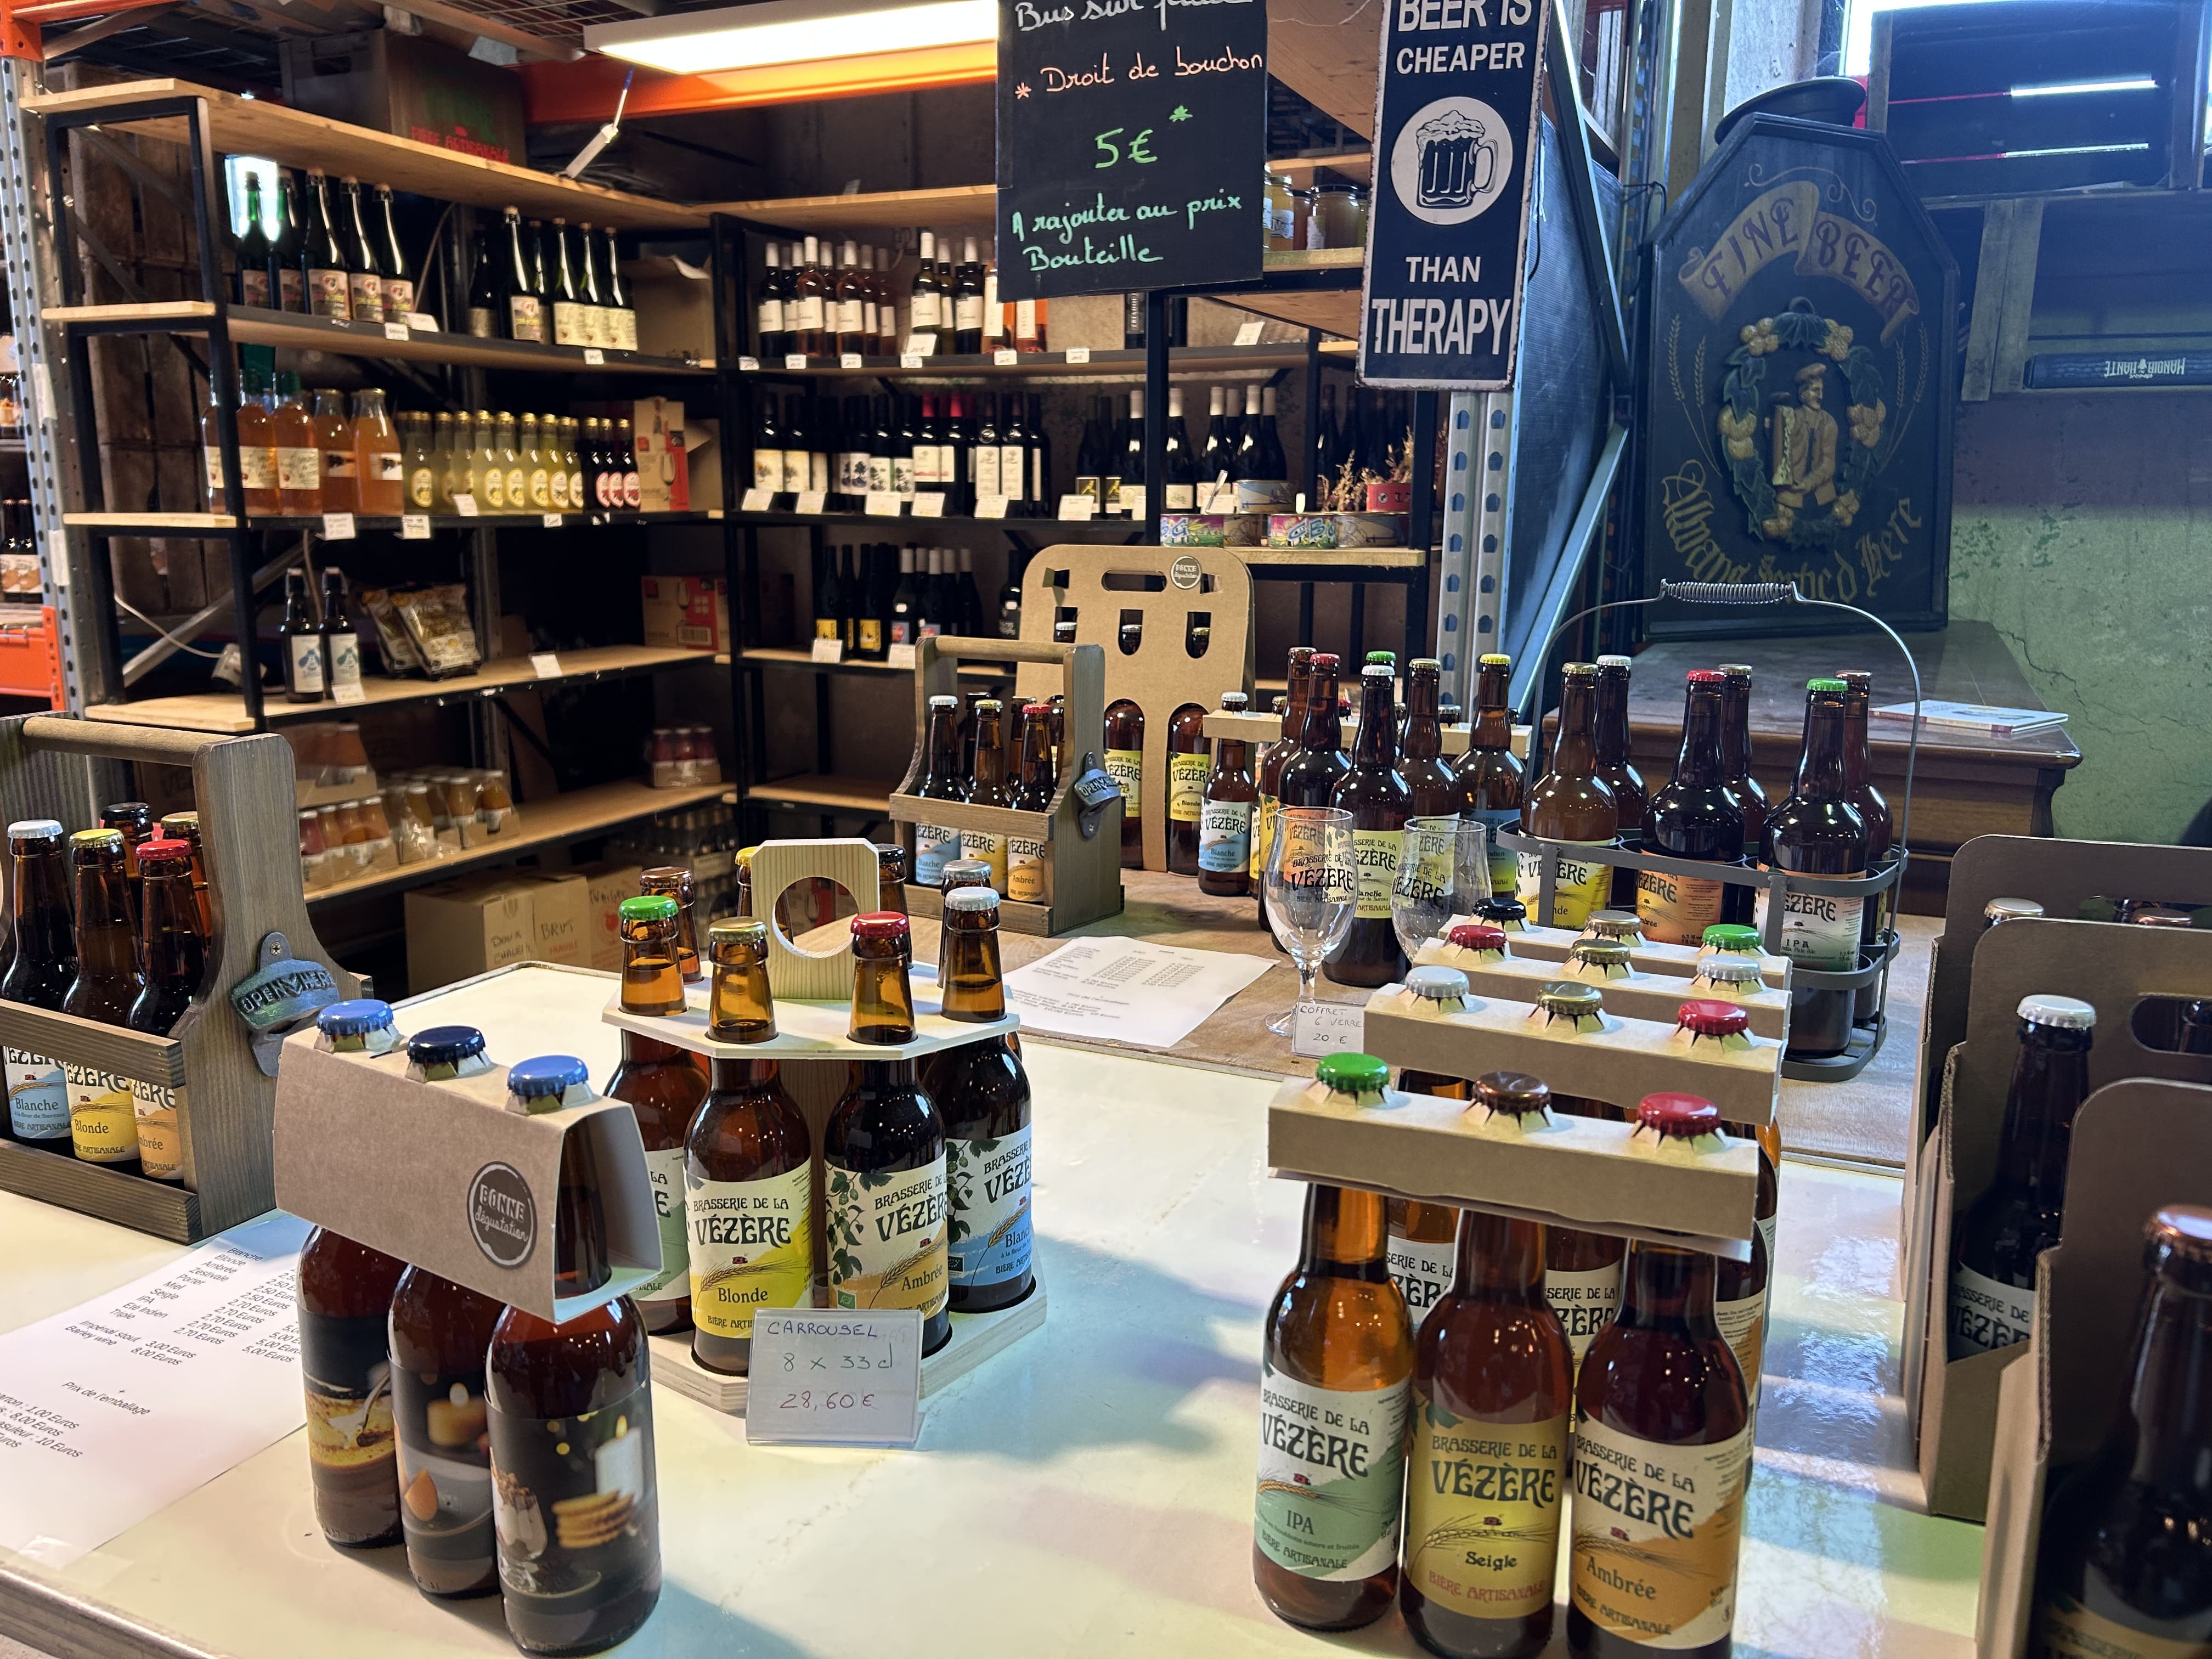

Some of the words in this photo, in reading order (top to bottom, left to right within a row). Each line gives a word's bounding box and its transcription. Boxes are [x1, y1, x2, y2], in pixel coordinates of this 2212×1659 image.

[1015, 2, 1075, 31] Bus
[1398, 0, 1486, 32] BEER
[1501, 0, 1531, 26] IS
[1396, 42, 1525, 75] CHEAPER
[1040, 52, 1115, 92] Droit
[1128, 53, 1159, 78] de
[1173, 46, 1263, 77] bouchon
[1012, 211, 1025, 241] A
[1032, 192, 1131, 244] rajouter
[1136, 205, 1177, 219] au
[1186, 189, 1242, 230] prix
[1023, 234, 1163, 272] Bouteille
[1701, 196, 1802, 300] FINE
[1815, 221, 1910, 314] BEER
[1405, 256, 1481, 283] THAN
[1372, 298, 1511, 356] THERAPY
[2147, 357, 2186, 375] MANOIR
[1855, 497, 1922, 598] Here
[1205, 816, 1246, 834] VÉZÈRE
[1211, 848, 1235, 856] Blanche
[1388, 842, 1397, 851] LA
[1355, 848, 1396, 872] ÉZÈRE
[1013, 874, 1036, 884] Ambrée
[1291, 866, 1354, 893] VÉZÈRE
[1423, 865, 1432, 877] DE
[1435, 871, 1446, 884] LA
[541, 919, 574, 939] BRUT
[1786, 939, 1809, 949] IPA
[1300, 1006, 1348, 1015] COFFRET
[1314, 1017, 1323, 1025] 6
[15, 1097, 59, 1111] Blanche
[75, 1119, 109, 1134] Blonde
[83, 1146, 126, 1155] ARTISANALE
[138, 1134, 163, 1150] mbrée
[984, 1139, 1029, 1175] BRASSERIE
[650, 1171, 668, 1185] LA
[984, 1156, 1031, 1204] VÉZÈ
[479, 1183, 525, 1223] BONNE
[874, 1178, 933, 1210] BRASSERIE
[935, 1176, 943, 1187] DE
[693, 1198, 747, 1212] BRASSERIE
[753, 1198, 768, 1209] DE
[774, 1198, 789, 1210] LA
[474, 1205, 529, 1242] dégustation
[695, 1214, 791, 1248] VÉZÈRE
[214, 1254, 246, 1266] Blonde
[227, 1247, 263, 1262] Blanche
[189, 1267, 229, 1282] Zestivale
[201, 1261, 238, 1274] Ambrée
[995, 1262, 1014, 1274] BIÈRE
[1421, 1260, 1437, 1274] DE
[162, 1280, 187, 1290] Miel
[176, 1273, 207, 1286] Porter
[901, 1264, 943, 1291] Ambrée
[136, 1295, 156, 1305] IPA
[240, 1292, 264, 1302] 2,50
[262, 1297, 291, 1310] Euros
[150, 1288, 180, 1301] Seigle
[253, 1285, 276, 1295] 2,50
[718, 1288, 768, 1303] Blonde
[1587, 1287, 1600, 1299] DE
[1604, 1288, 1615, 1300] LA
[110, 1308, 136, 1320] Triple
[214, 1306, 238, 1317] 2,70
[236, 1312, 265, 1324] Euros
[138, 1307, 169, 1319] Indien
[228, 1299, 251, 1309] 2,70
[249, 1304, 278, 1317] Euros
[2010, 1305, 2030, 1324] DE
[187, 1321, 211, 1331] 2,70
[208, 1325, 239, 1339] Euros
[201, 1313, 224, 1324] 2,70
[222, 1318, 252, 1331] Euros
[707, 1316, 727, 1328] BIÈRE
[768, 1320, 877, 1337] CARROUSEL
[64, 1325, 98, 1339] Barley
[94, 1335, 118, 1346] wine
[167, 1346, 197, 1359] Euros
[256, 1339, 280, 1349] 5,00
[79, 1320, 119, 1336] Impérial
[115, 1331, 141, 1342] stout
[173, 1327, 197, 1338] 2,70
[195, 1333, 225, 1345] Euros
[269, 1332, 294, 1342] 5,00
[151, 1353, 182, 1366] Euros
[242, 1345, 266, 1356] 5,00
[263, 1351, 295, 1364] Euros
[783, 1352, 794, 1372] 8
[810, 1357, 826, 1370] x
[61, 1381, 82, 1393] Prix
[81, 1389, 97, 1397] de
[94, 1393, 151, 1415] l'emballage
[48, 1414, 80, 1430] Euros
[1263, 1388, 1318, 1420] BRASSERIE
[1325, 1409, 1344, 1428] DE
[1350, 1417, 1370, 1436] LA
[31, 1421, 64, 1437] Euros
[35, 1437, 55, 1446] 10
[50, 1442, 83, 1458] Euros
[1262, 1412, 1369, 1480] VÉZÈRE
[1432, 1435, 1511, 1458] BRASSERIE
[1519, 1443, 1536, 1459] DE
[1541, 1444, 1557, 1459] LA
[1576, 1434, 1637, 1472] BRASSERIE
[1644, 1462, 1664, 1482] DE
[1672, 1472, 1696, 1493] LA
[1431, 1458, 1555, 1508] VÉZÈRE
[1575, 1459, 1695, 1542] VÉZÈRE
[1286, 1510, 1314, 1535] IPA
[1262, 1529, 1280, 1552] BIÈRE
[1283, 1546, 1348, 1569] ARTISANALE
[1465, 1551, 1517, 1571] Seigle
[1428, 1570, 1462, 1598] BIÈRE
[1466, 1581, 1545, 1604] ARTISANALE
[1586, 1556, 1657, 1600] Ambrée
[1599, 1603, 1673, 1636] ARTISANALE
